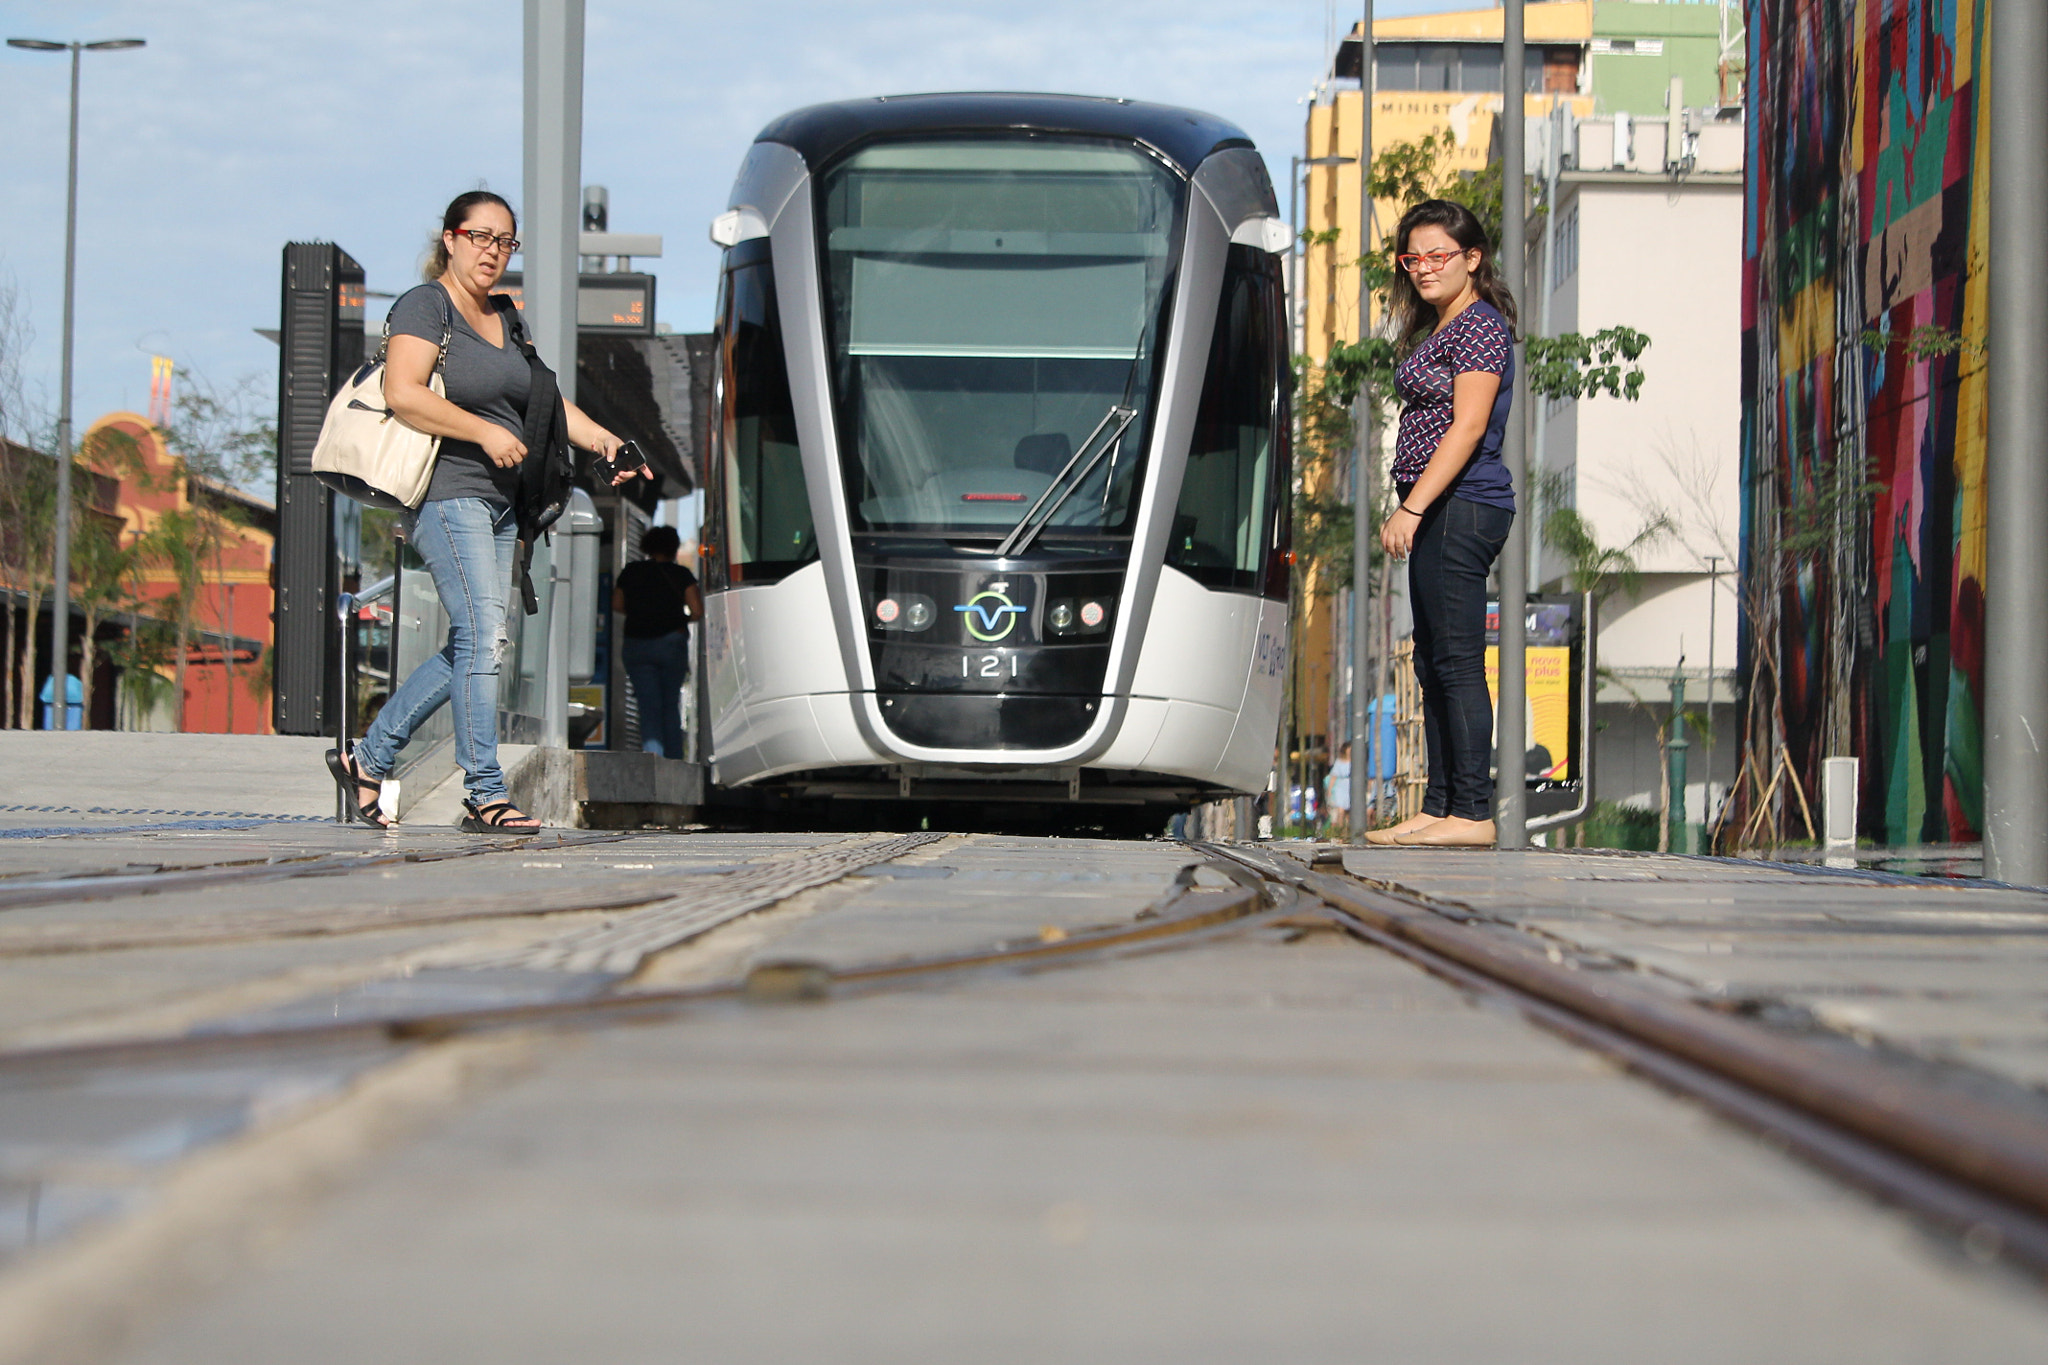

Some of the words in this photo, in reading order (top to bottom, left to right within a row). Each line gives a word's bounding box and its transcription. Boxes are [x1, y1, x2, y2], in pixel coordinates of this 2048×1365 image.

[962, 655, 1017, 677] 121
[1530, 656, 1561, 665] novo
[1534, 666, 1561, 678] plus
